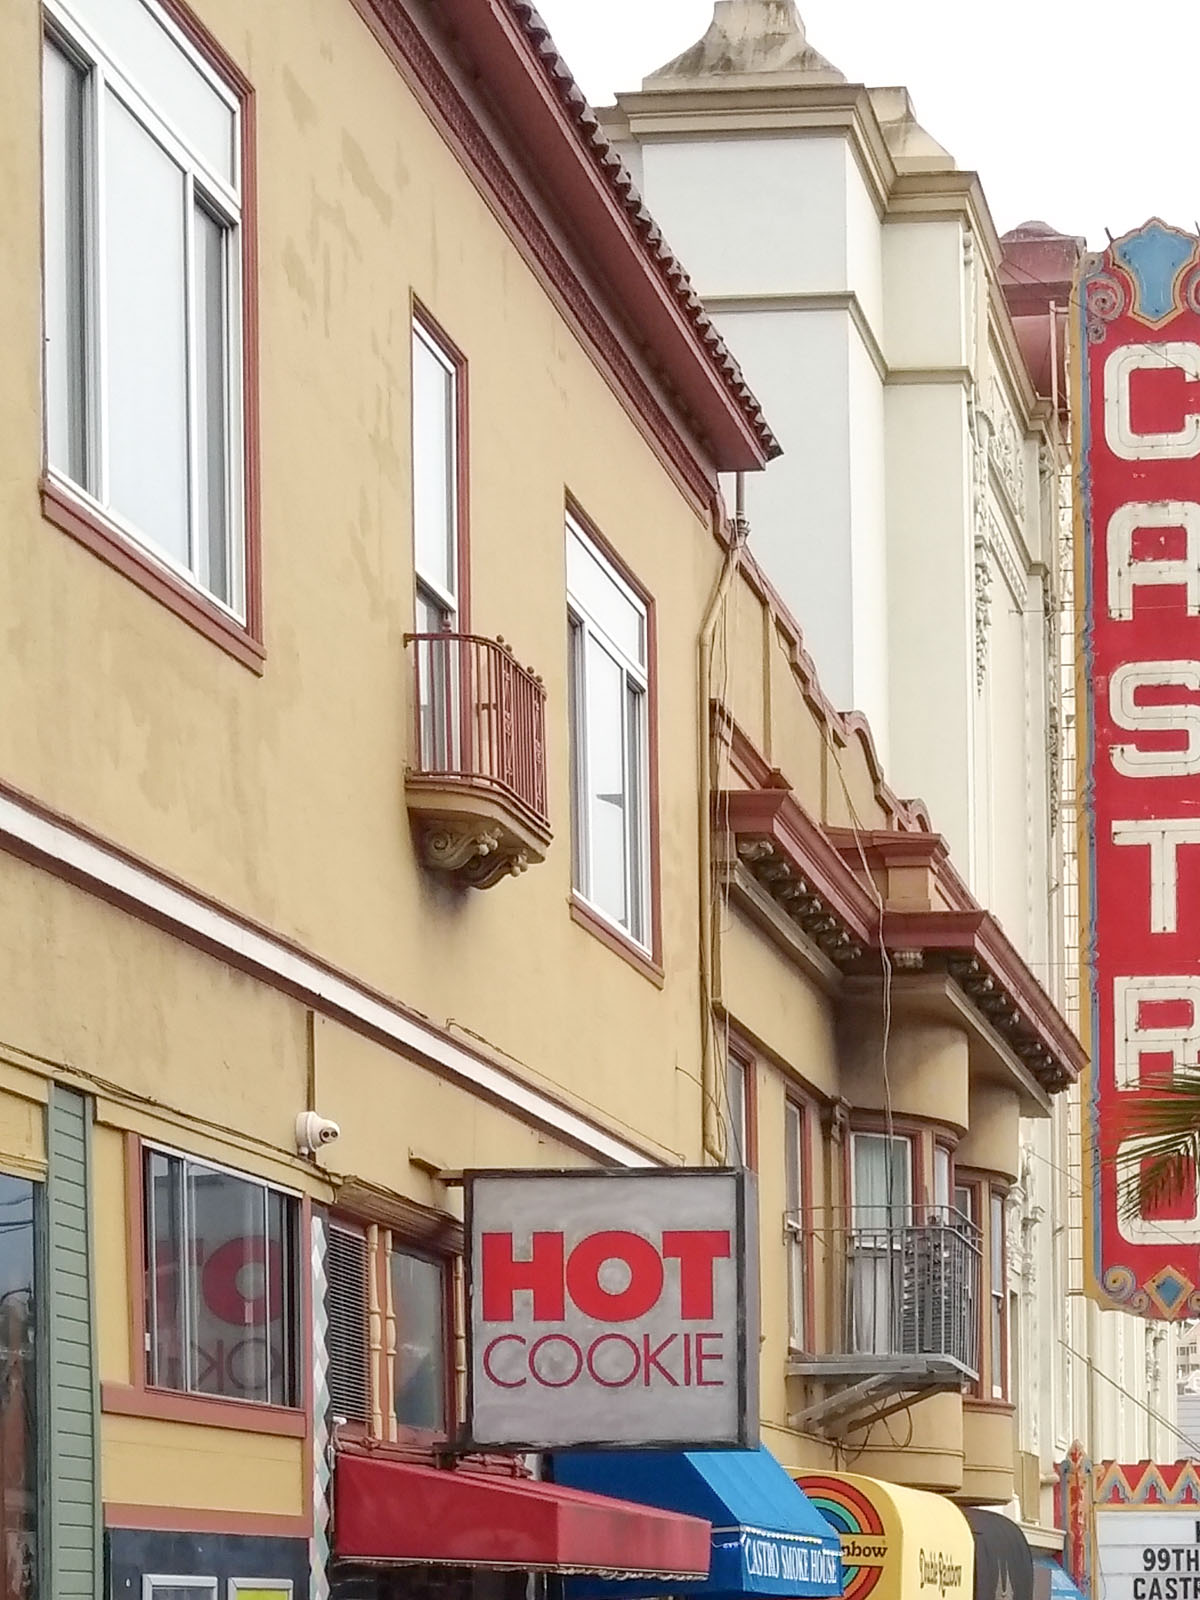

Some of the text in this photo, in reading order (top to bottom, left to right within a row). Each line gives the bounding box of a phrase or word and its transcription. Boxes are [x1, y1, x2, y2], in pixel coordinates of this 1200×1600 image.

[482, 1230, 731, 1322] HOT
[483, 1333, 725, 1389] COOKIE
[745, 1538, 838, 1584] CASTRO SMOKE HOUSE
[1143, 1548, 1200, 1572] 99TH
